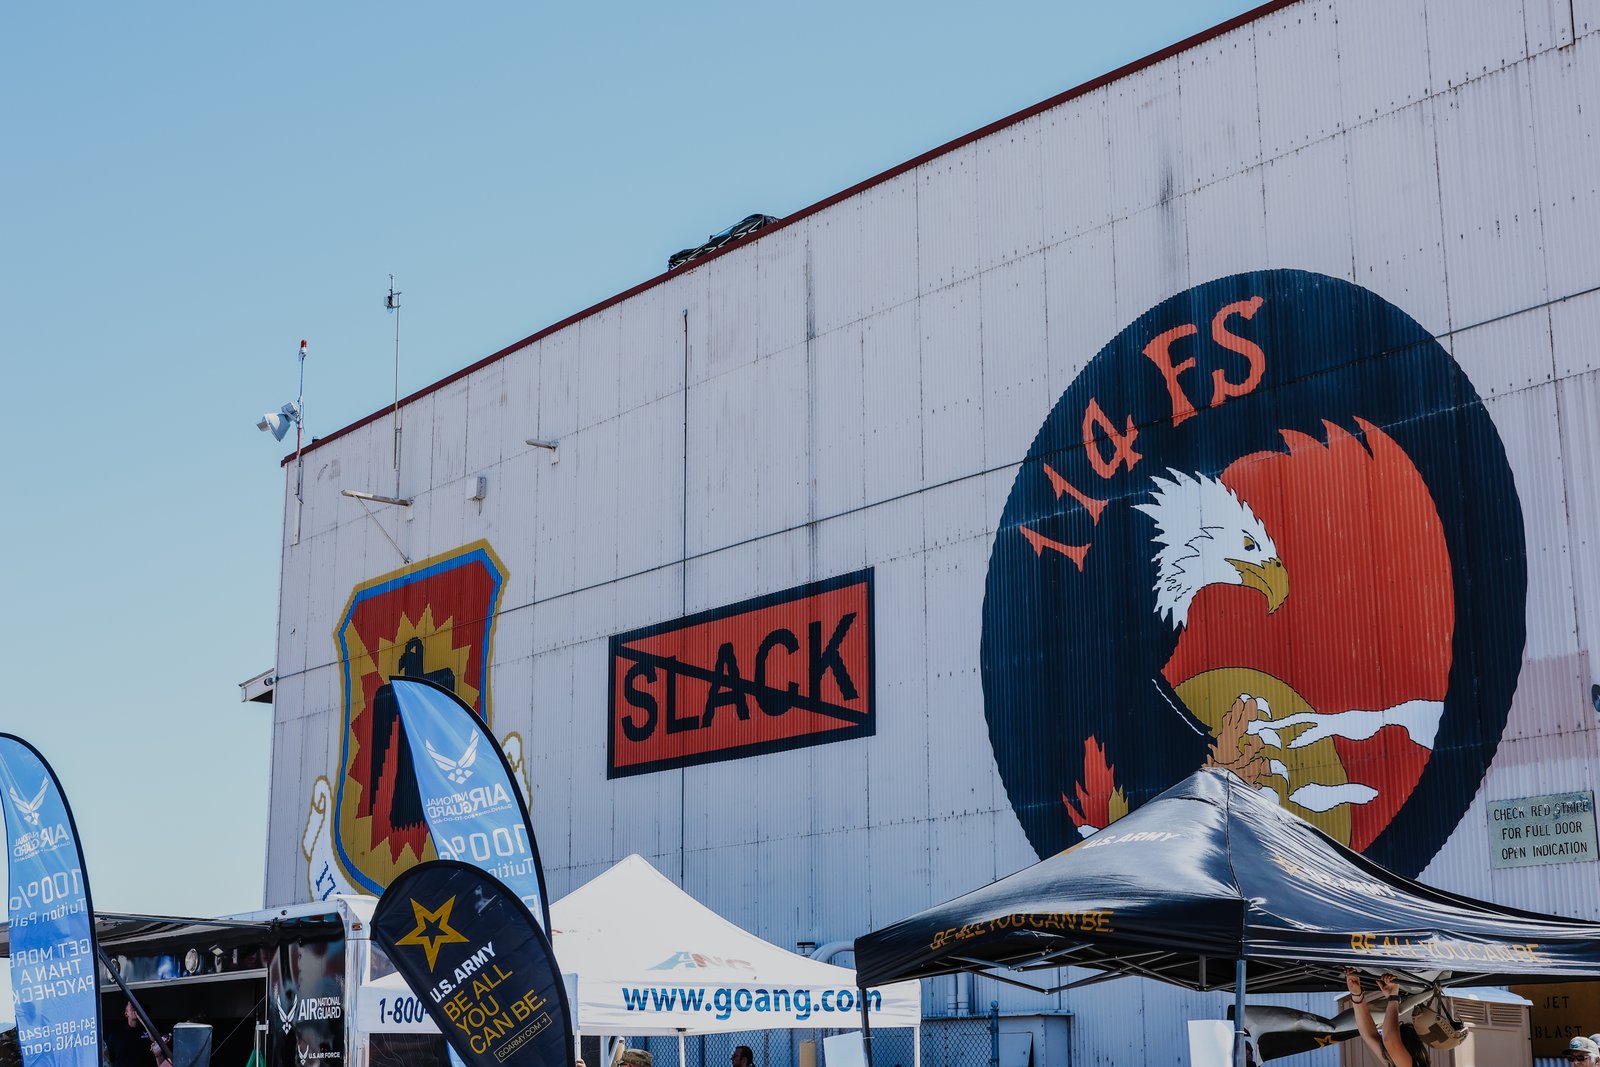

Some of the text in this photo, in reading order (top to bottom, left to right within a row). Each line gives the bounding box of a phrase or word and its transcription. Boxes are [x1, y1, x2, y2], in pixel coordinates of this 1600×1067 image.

[1019, 296, 1266, 573] 114 FS
[621, 611, 860, 743] SLACK
[1493, 806, 1525, 821] CHECK
[1530, 804, 1551, 817] RED
[1502, 821, 1583, 840] FOR FULL DOOR
[1501, 841, 1588, 860] OPEN INDICATION
[430, 941, 497, 1004] U.S. ARMY
[317, 996, 341, 1007] NATIONAL
[443, 964, 513, 1022] BE ALL
[621, 986, 882, 1021] www.goang.com
[1543, 995, 1569, 1009] JET
[298, 998, 318, 1021] AIR
[317, 1006, 341, 1020] GUARD
[456, 995, 501, 1036] YOU
[469, 989, 548, 1055] CAN BE.
[1535, 1025, 1583, 1039] BLAST
[498, 1022, 542, 1059] GOARMY.COM
[324, 1051, 341, 1059] FORCE
